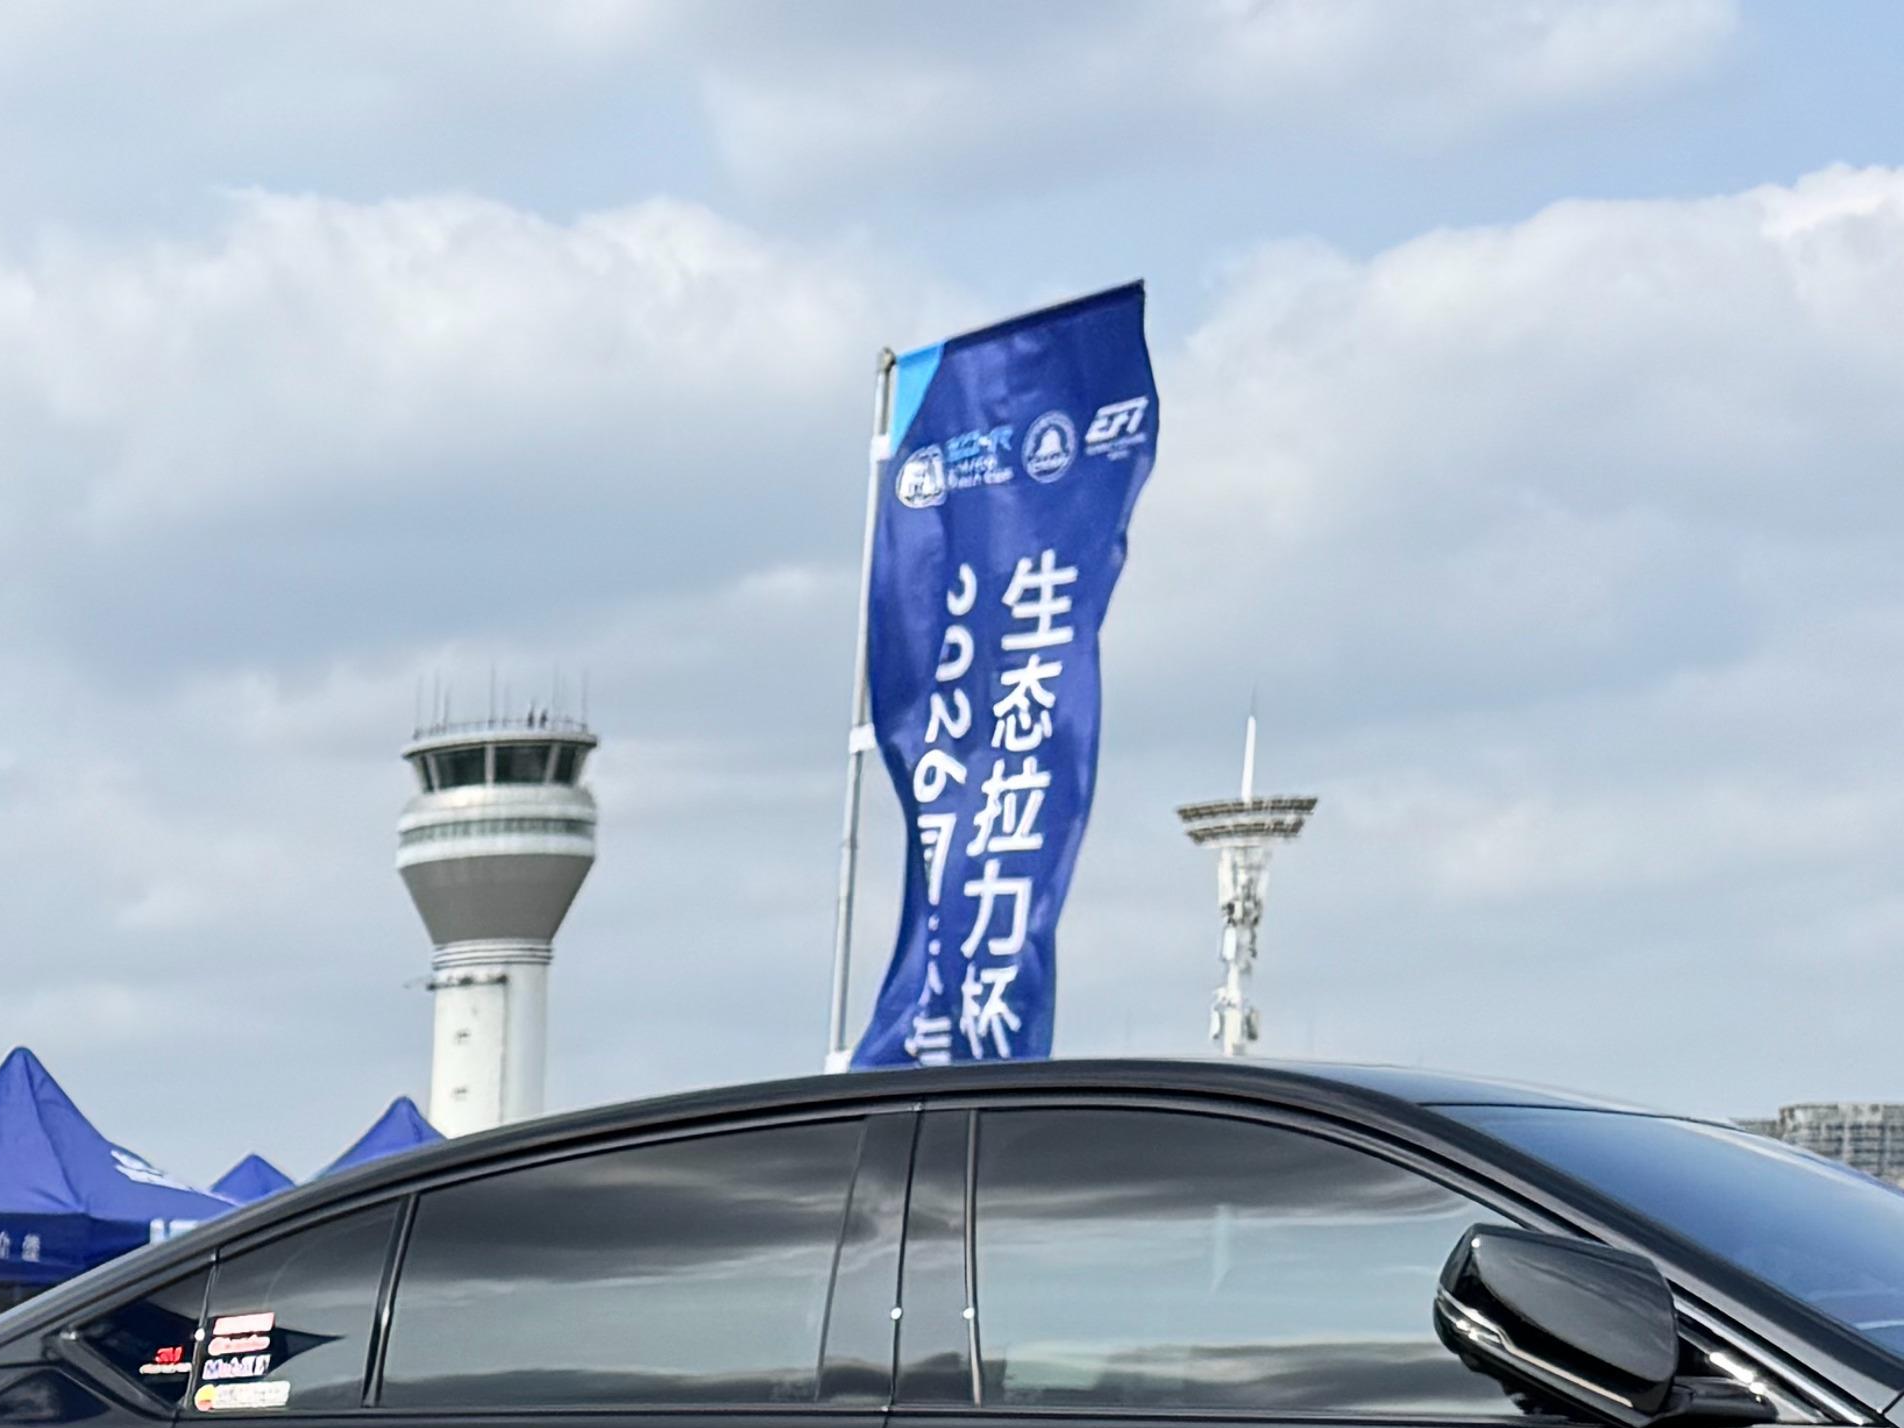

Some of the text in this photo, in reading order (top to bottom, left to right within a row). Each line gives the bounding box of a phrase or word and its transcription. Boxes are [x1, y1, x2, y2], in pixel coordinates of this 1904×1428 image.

[961, 549, 1078, 1061] 生态拉力杯
